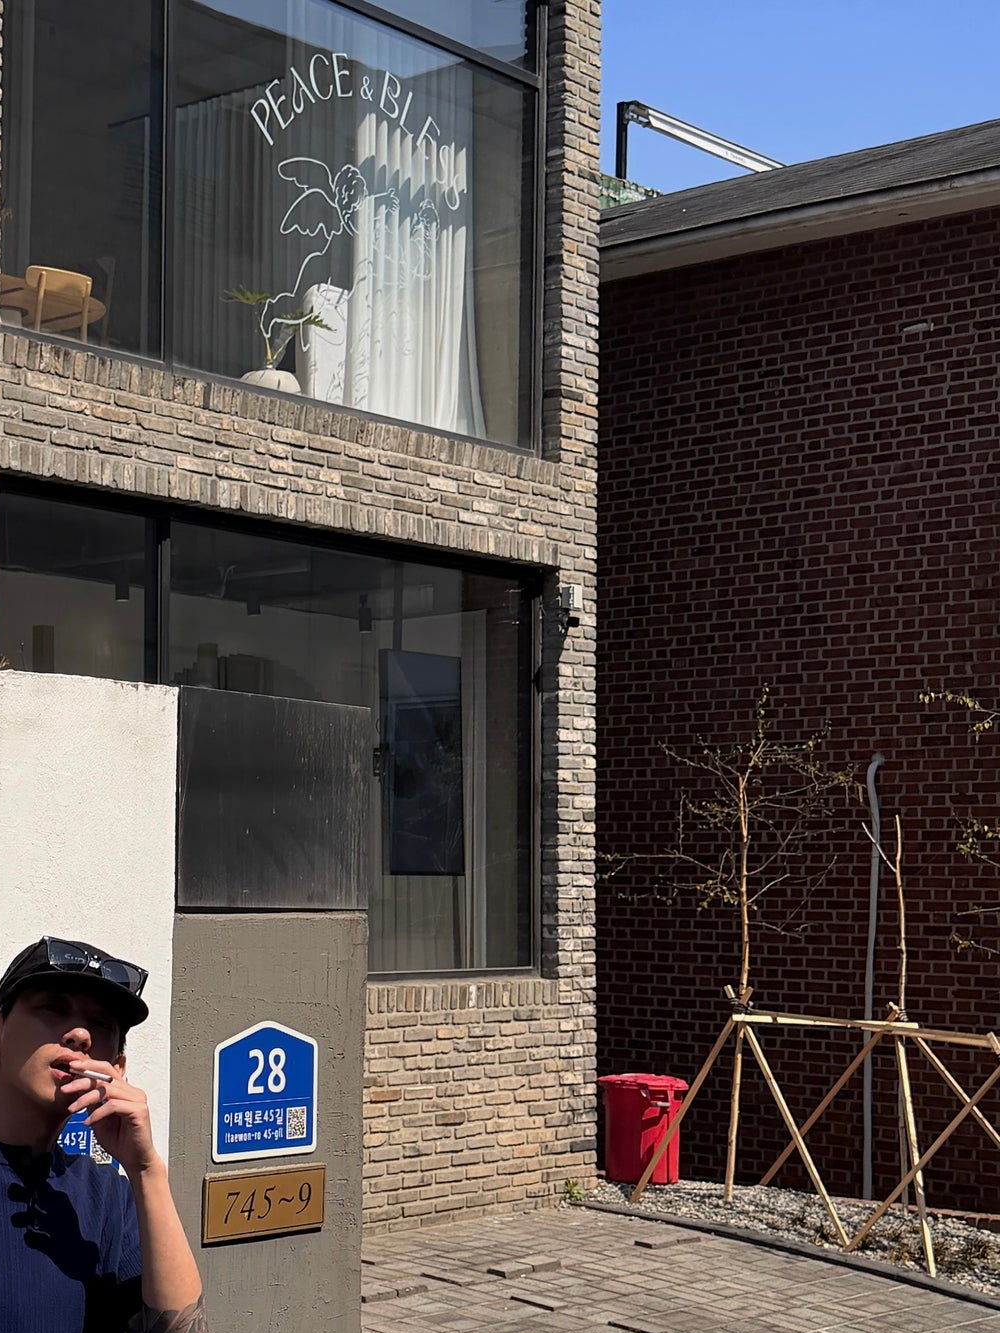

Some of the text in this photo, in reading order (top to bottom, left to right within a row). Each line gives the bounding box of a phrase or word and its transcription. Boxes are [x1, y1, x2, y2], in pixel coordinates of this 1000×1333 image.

[250, 53, 353, 146] PEACE
[360, 75, 374, 102] &
[247, 1047, 286, 1094] 28
[223, 1107, 284, 1128] 이태원로45길
[263, 1127, 284, 1140] 45-gil
